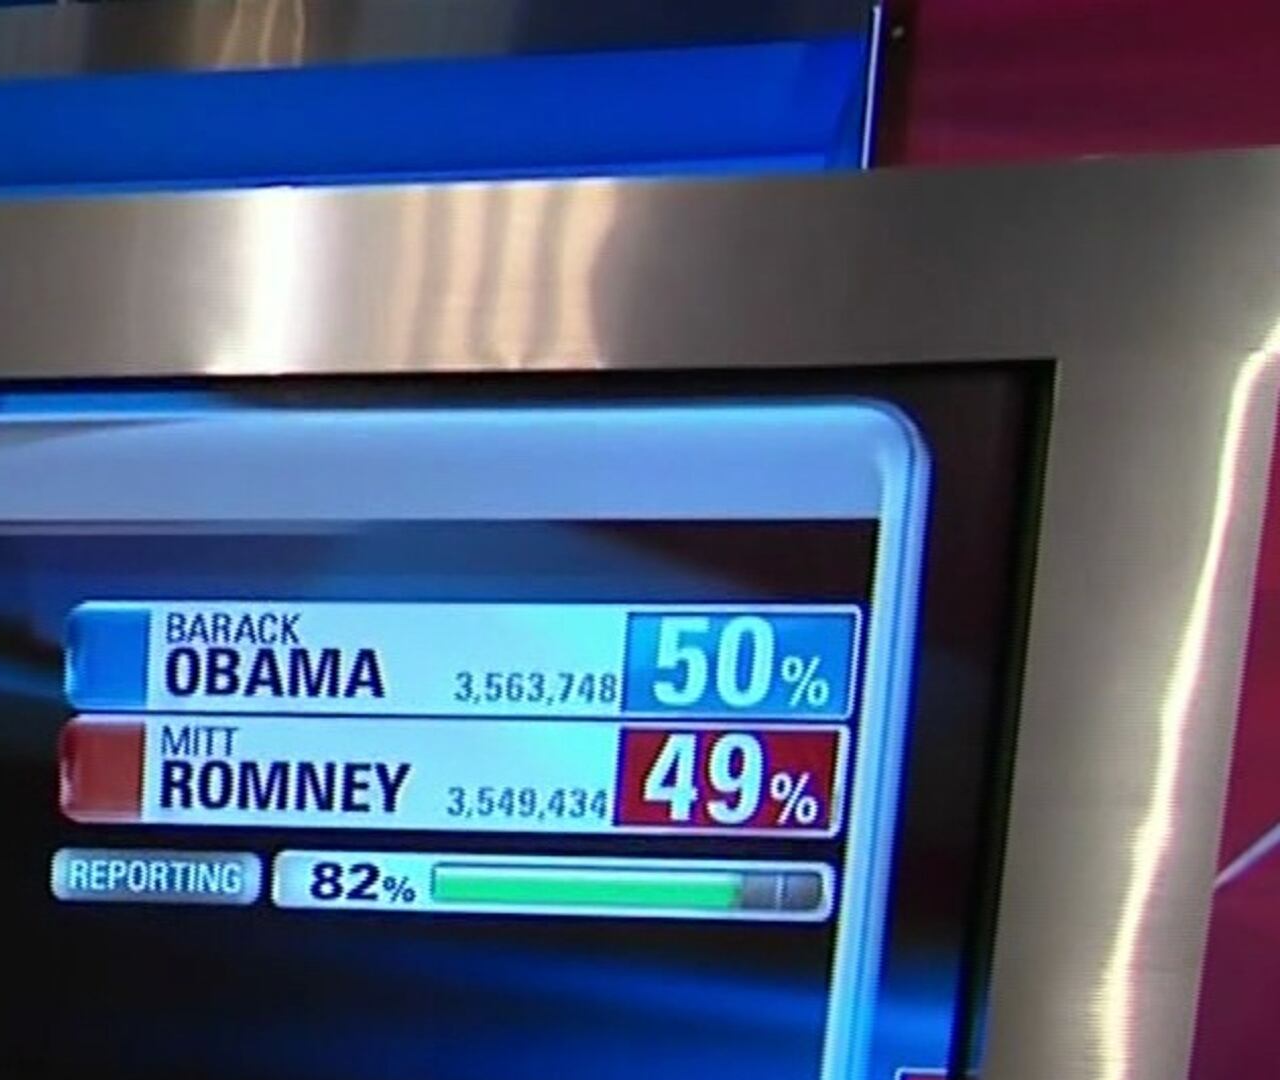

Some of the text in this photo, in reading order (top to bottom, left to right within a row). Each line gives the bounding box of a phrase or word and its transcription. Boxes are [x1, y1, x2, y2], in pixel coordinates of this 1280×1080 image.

[165, 611, 301, 647] BARACK
[165, 614, 831, 710] OBAMA 3,563,748 50%
[160, 725, 240, 759] MITT
[158, 732, 820, 826] ROMNEY 3,549,434 49%
[68, 860, 245, 897] REPORTING
[308, 861, 417, 905] 82%
